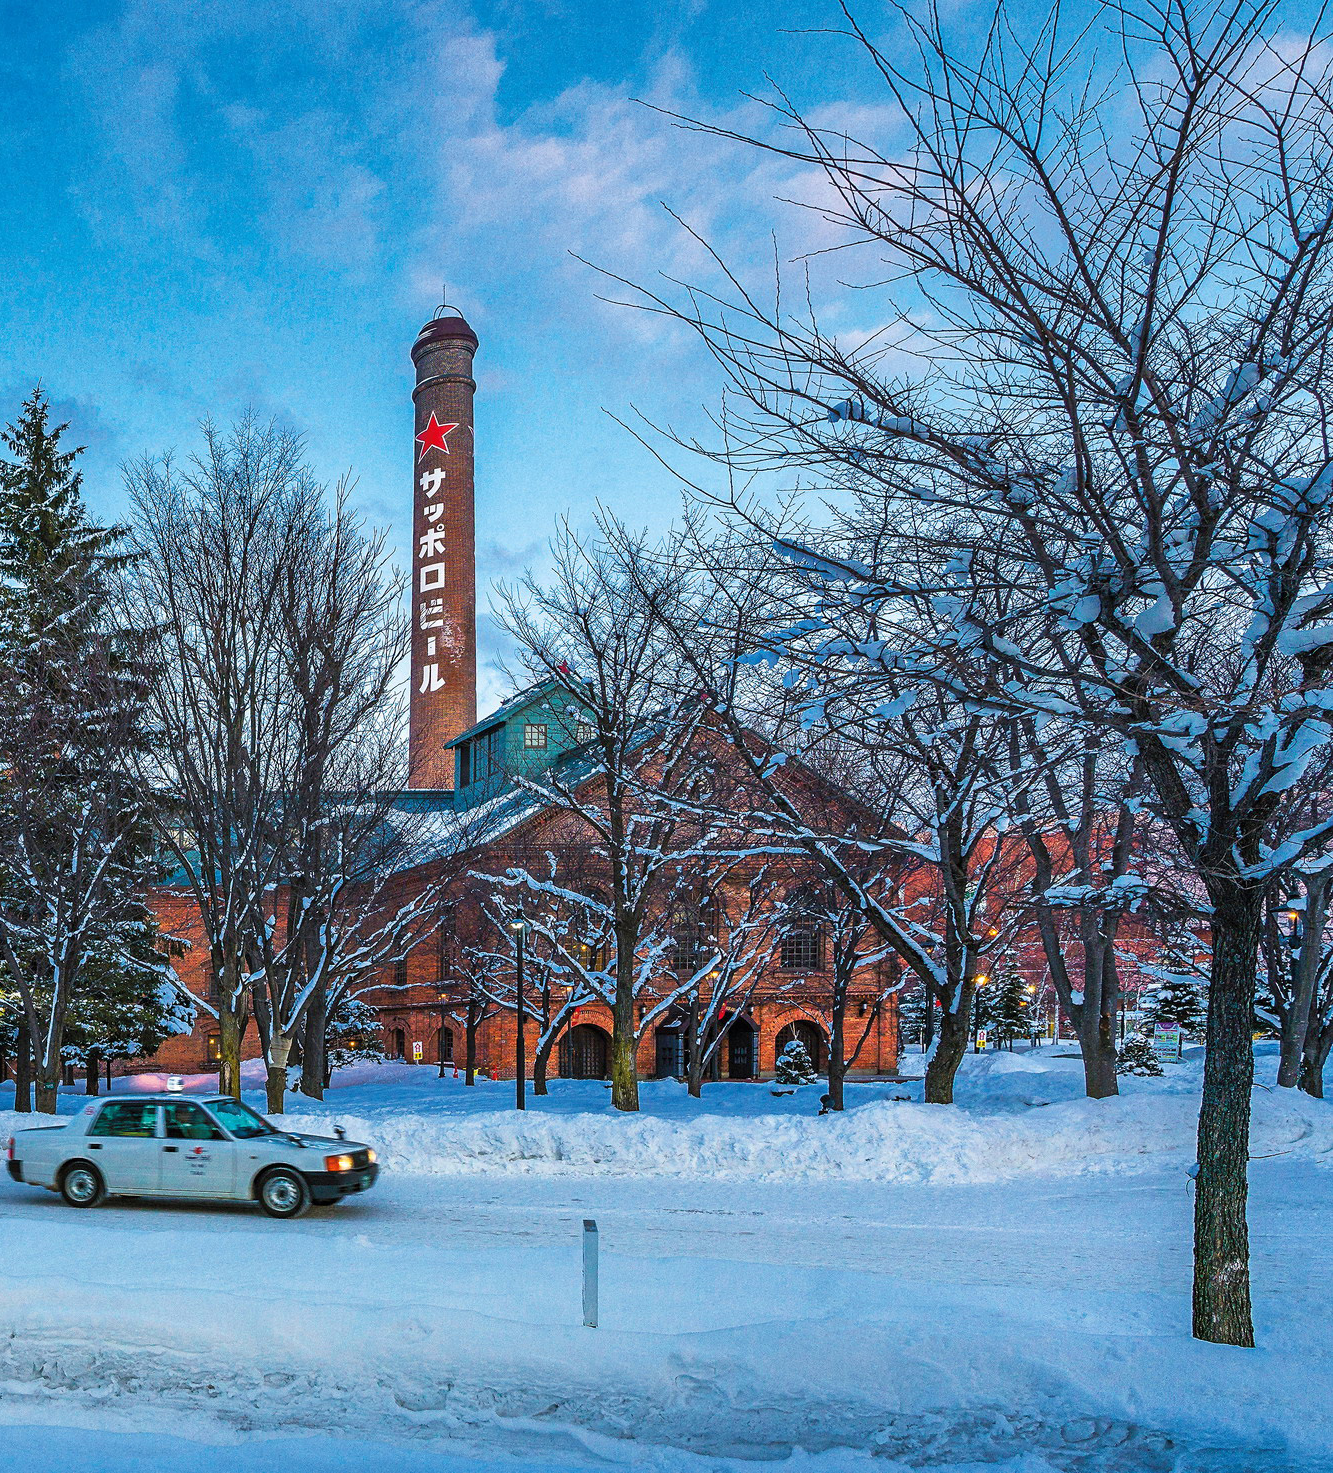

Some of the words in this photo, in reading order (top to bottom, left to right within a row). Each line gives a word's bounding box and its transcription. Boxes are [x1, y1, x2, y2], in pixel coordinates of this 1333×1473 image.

[419, 468, 446, 693] サッポロビール
